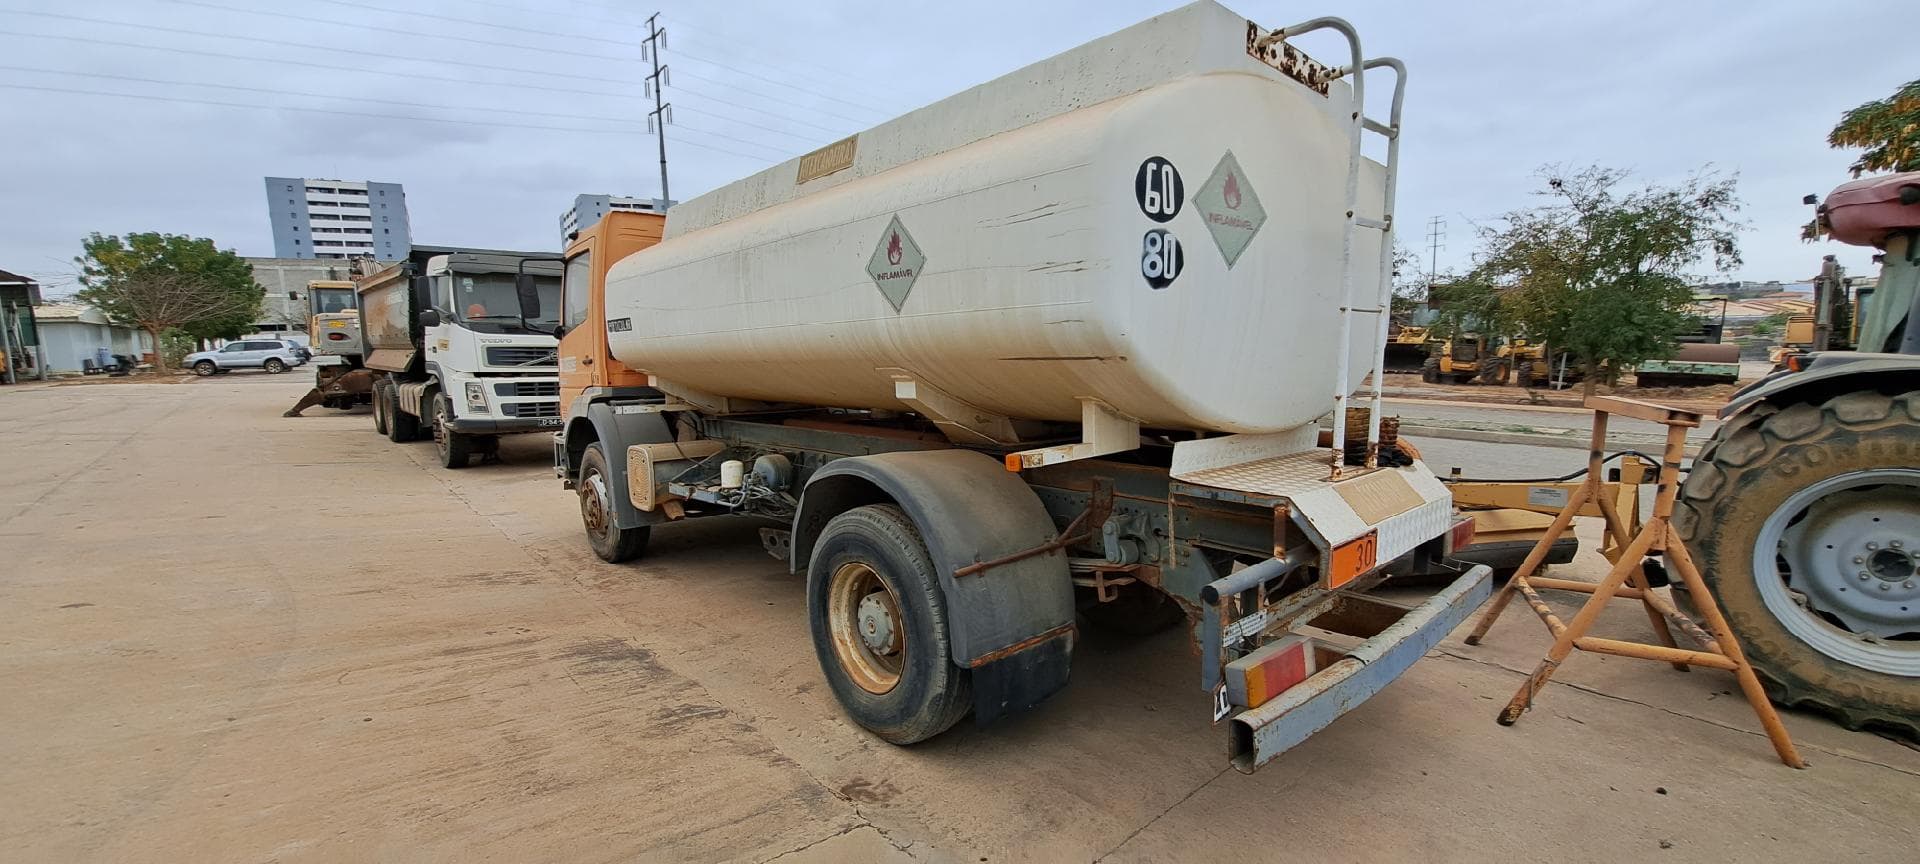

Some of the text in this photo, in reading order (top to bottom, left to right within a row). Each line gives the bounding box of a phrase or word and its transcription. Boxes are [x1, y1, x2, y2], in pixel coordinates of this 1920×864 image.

[1144, 162, 1175, 214] 60
[1142, 232, 1176, 279] 80
[1355, 539, 1373, 573] 30
